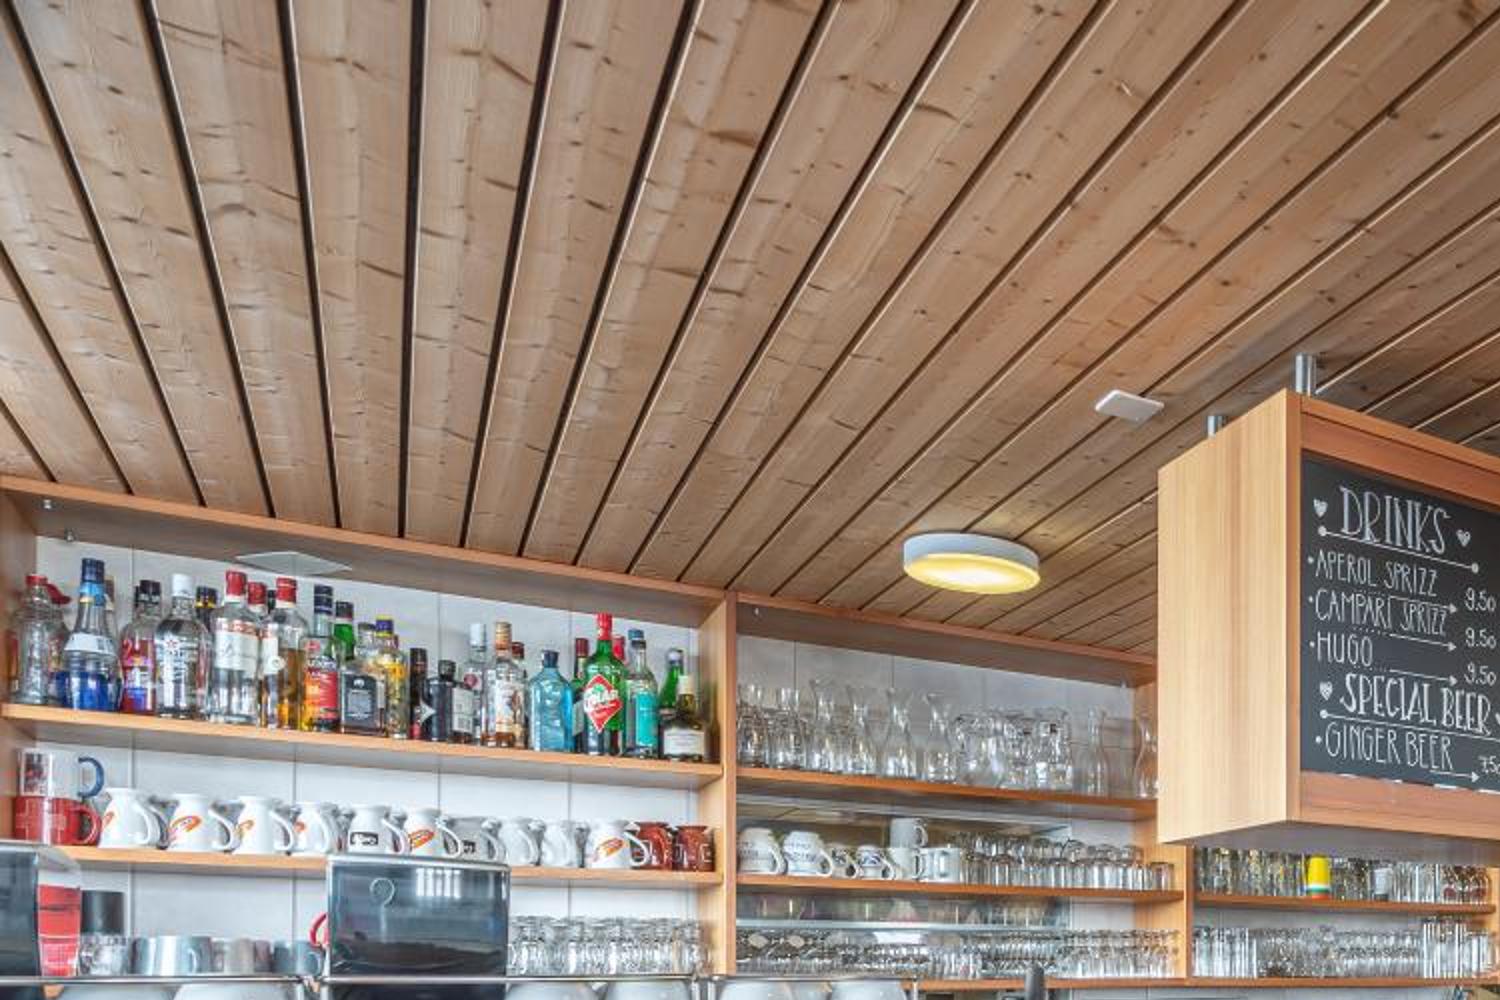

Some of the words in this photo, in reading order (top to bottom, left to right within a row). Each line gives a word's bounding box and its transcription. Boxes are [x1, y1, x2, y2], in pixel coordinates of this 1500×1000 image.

[1340, 486, 1450, 554] DRINKS
[1315, 549, 1377, 587] APEROL
[1384, 561, 1437, 597] SPRIZZ
[1464, 587, 1497, 612] 9.50
[1315, 588, 1392, 630] CAMPARI
[1401, 603, 1446, 636] SPRIZZ
[1464, 627, 1497, 649] 9.50
[1317, 630, 1373, 667] HUGO
[1464, 662, 1497, 687] 9.50
[1340, 673, 1437, 726] SPECIAL
[1441, 687, 1492, 737] BEER
[1325, 722, 1401, 765] GINGER
[1405, 731, 1454, 771] BEER
